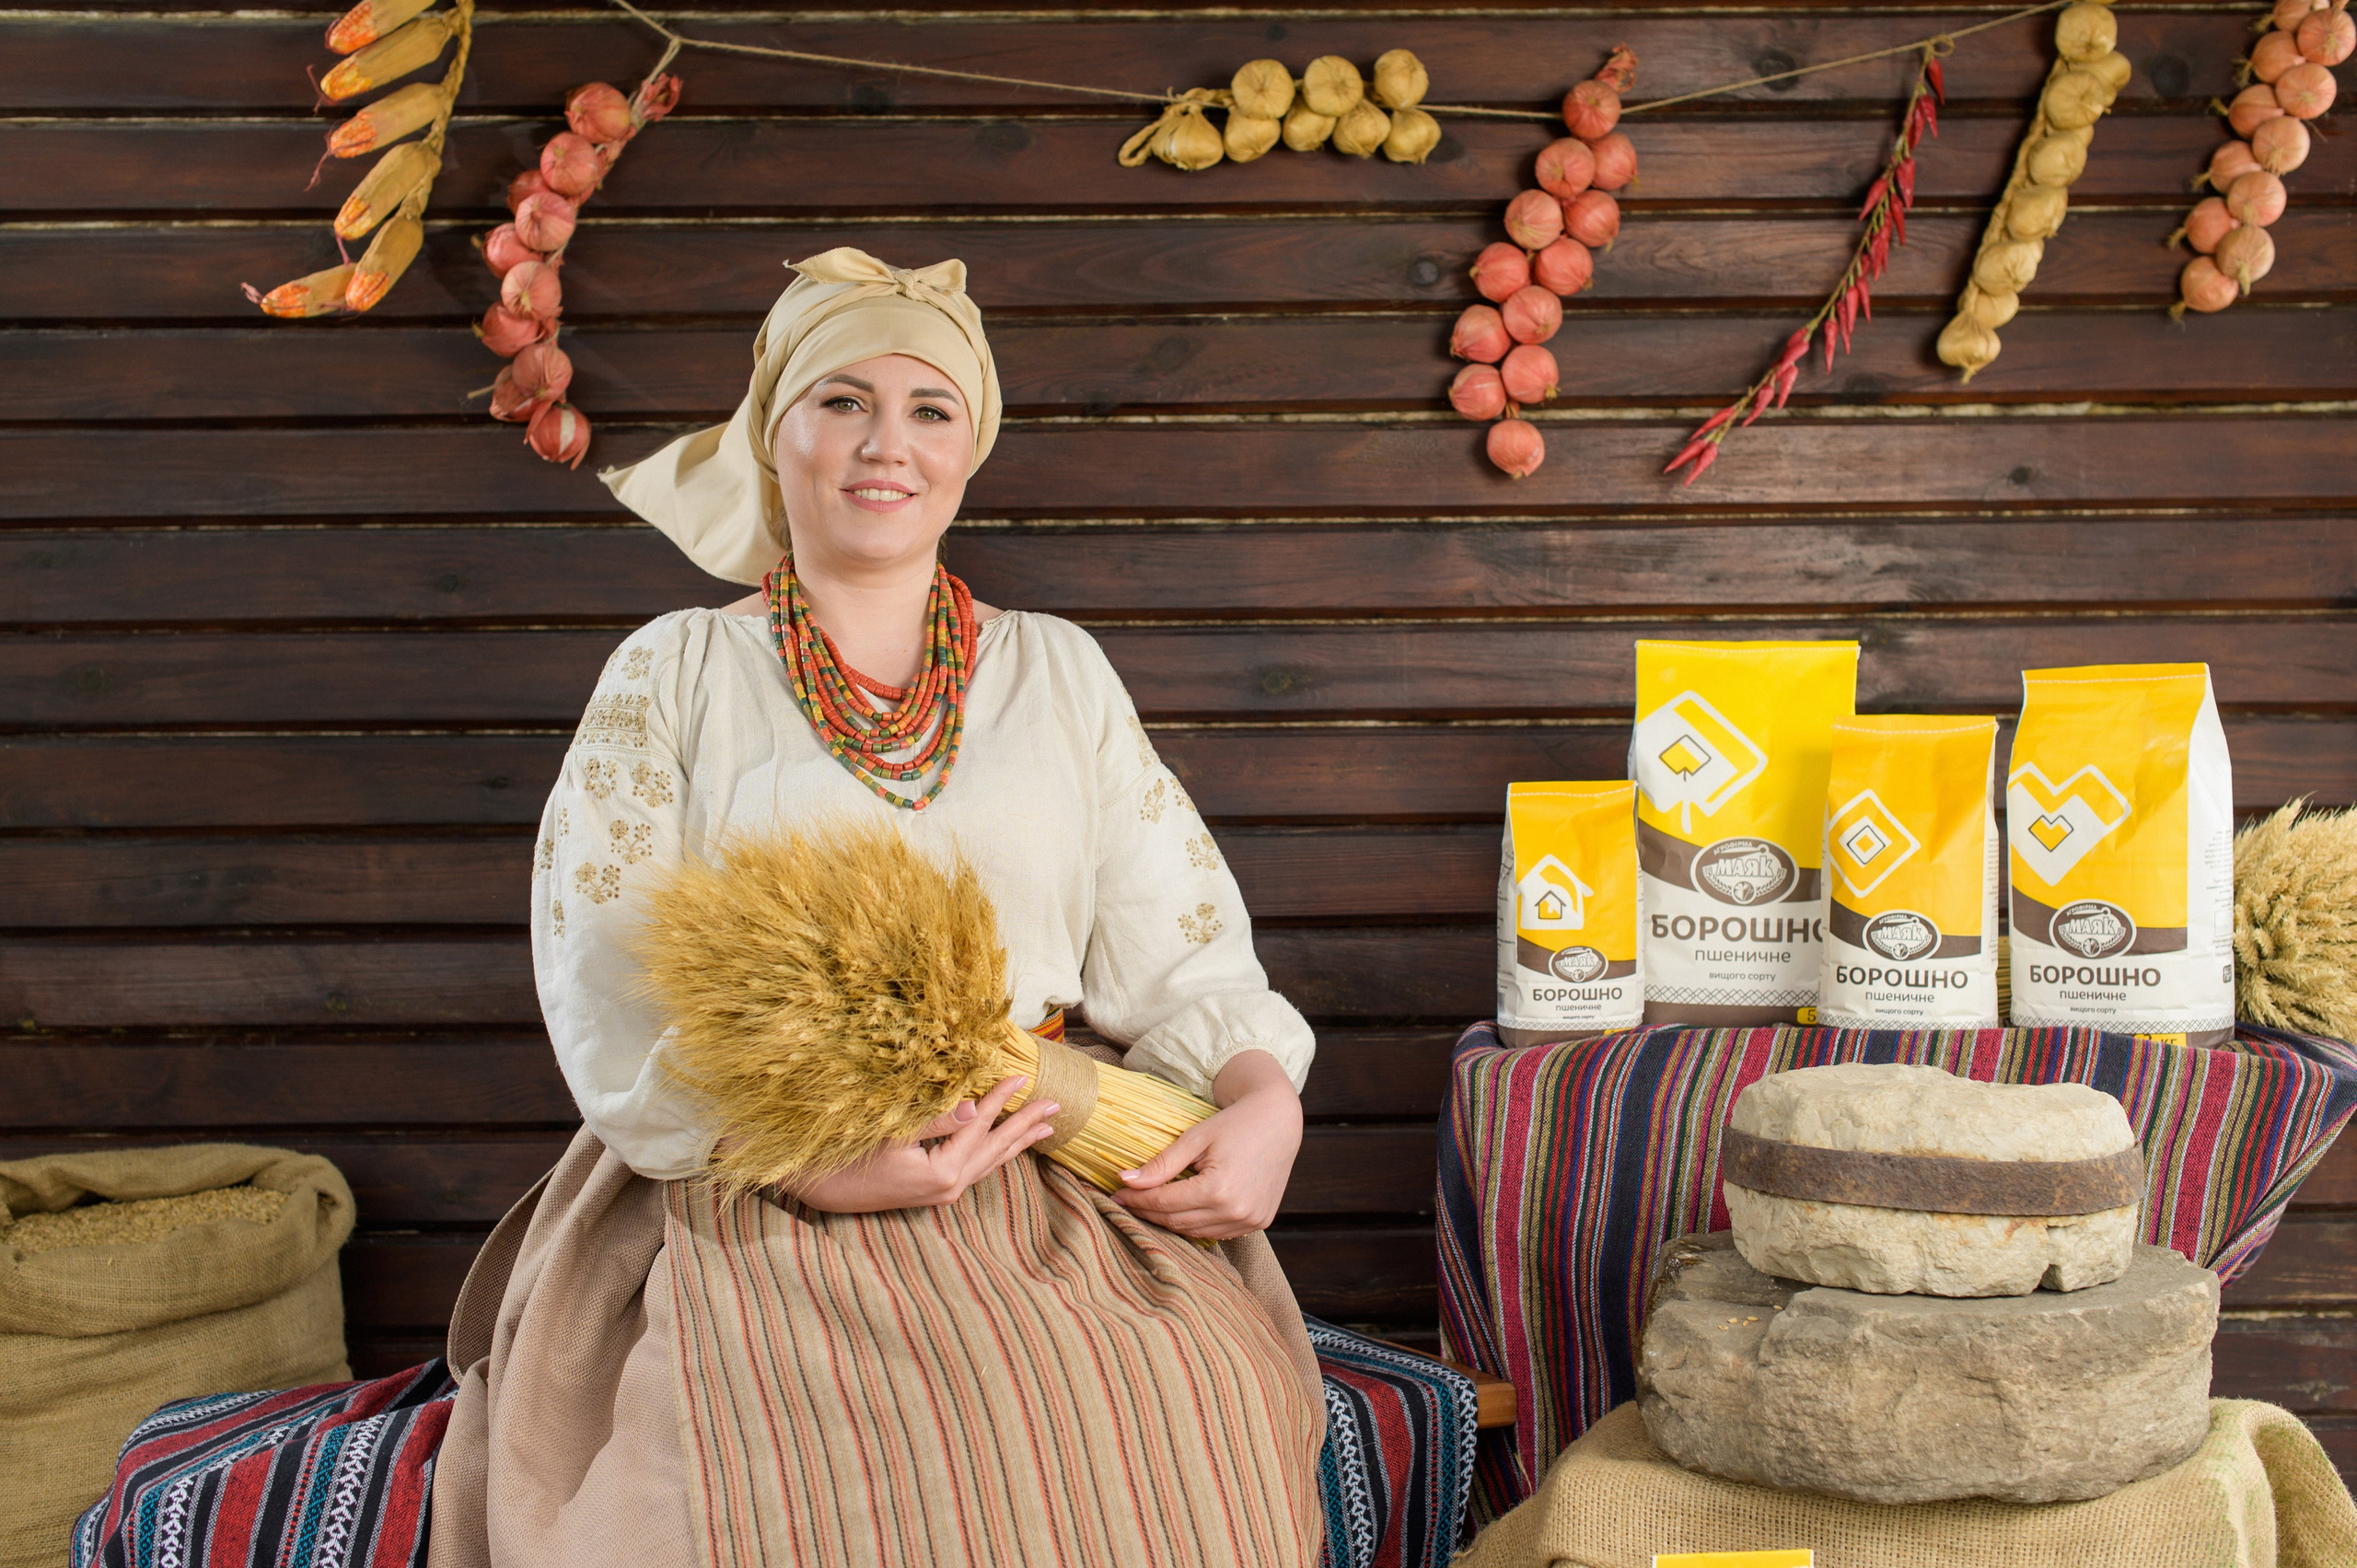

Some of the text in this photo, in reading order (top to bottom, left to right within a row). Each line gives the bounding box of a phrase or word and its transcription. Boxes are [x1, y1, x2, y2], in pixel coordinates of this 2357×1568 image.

[1713, 841, 1753, 855] АГРОФІРМА
[1715, 855, 1774, 877] МАЯК
[2066, 904, 2097, 916] АГРОФІРМА
[2069, 916, 2116, 935] МАЯК
[1880, 925, 1922, 941] МАЯК
[1562, 955, 1595, 967] МАЯК
[1695, 949, 1792, 963] пшеничне
[1709, 972, 1776, 981] вищого сорту
[1836, 965, 1968, 989] БОРОШНО
[2029, 964, 2161, 987] БОРОШНО
[1532, 987, 1622, 1002] БОРОШНО
[1865, 992, 1935, 1003] пшеничне
[2060, 990, 2127, 1001] пшеничне
[1806, 1009, 1817, 1022] 5
